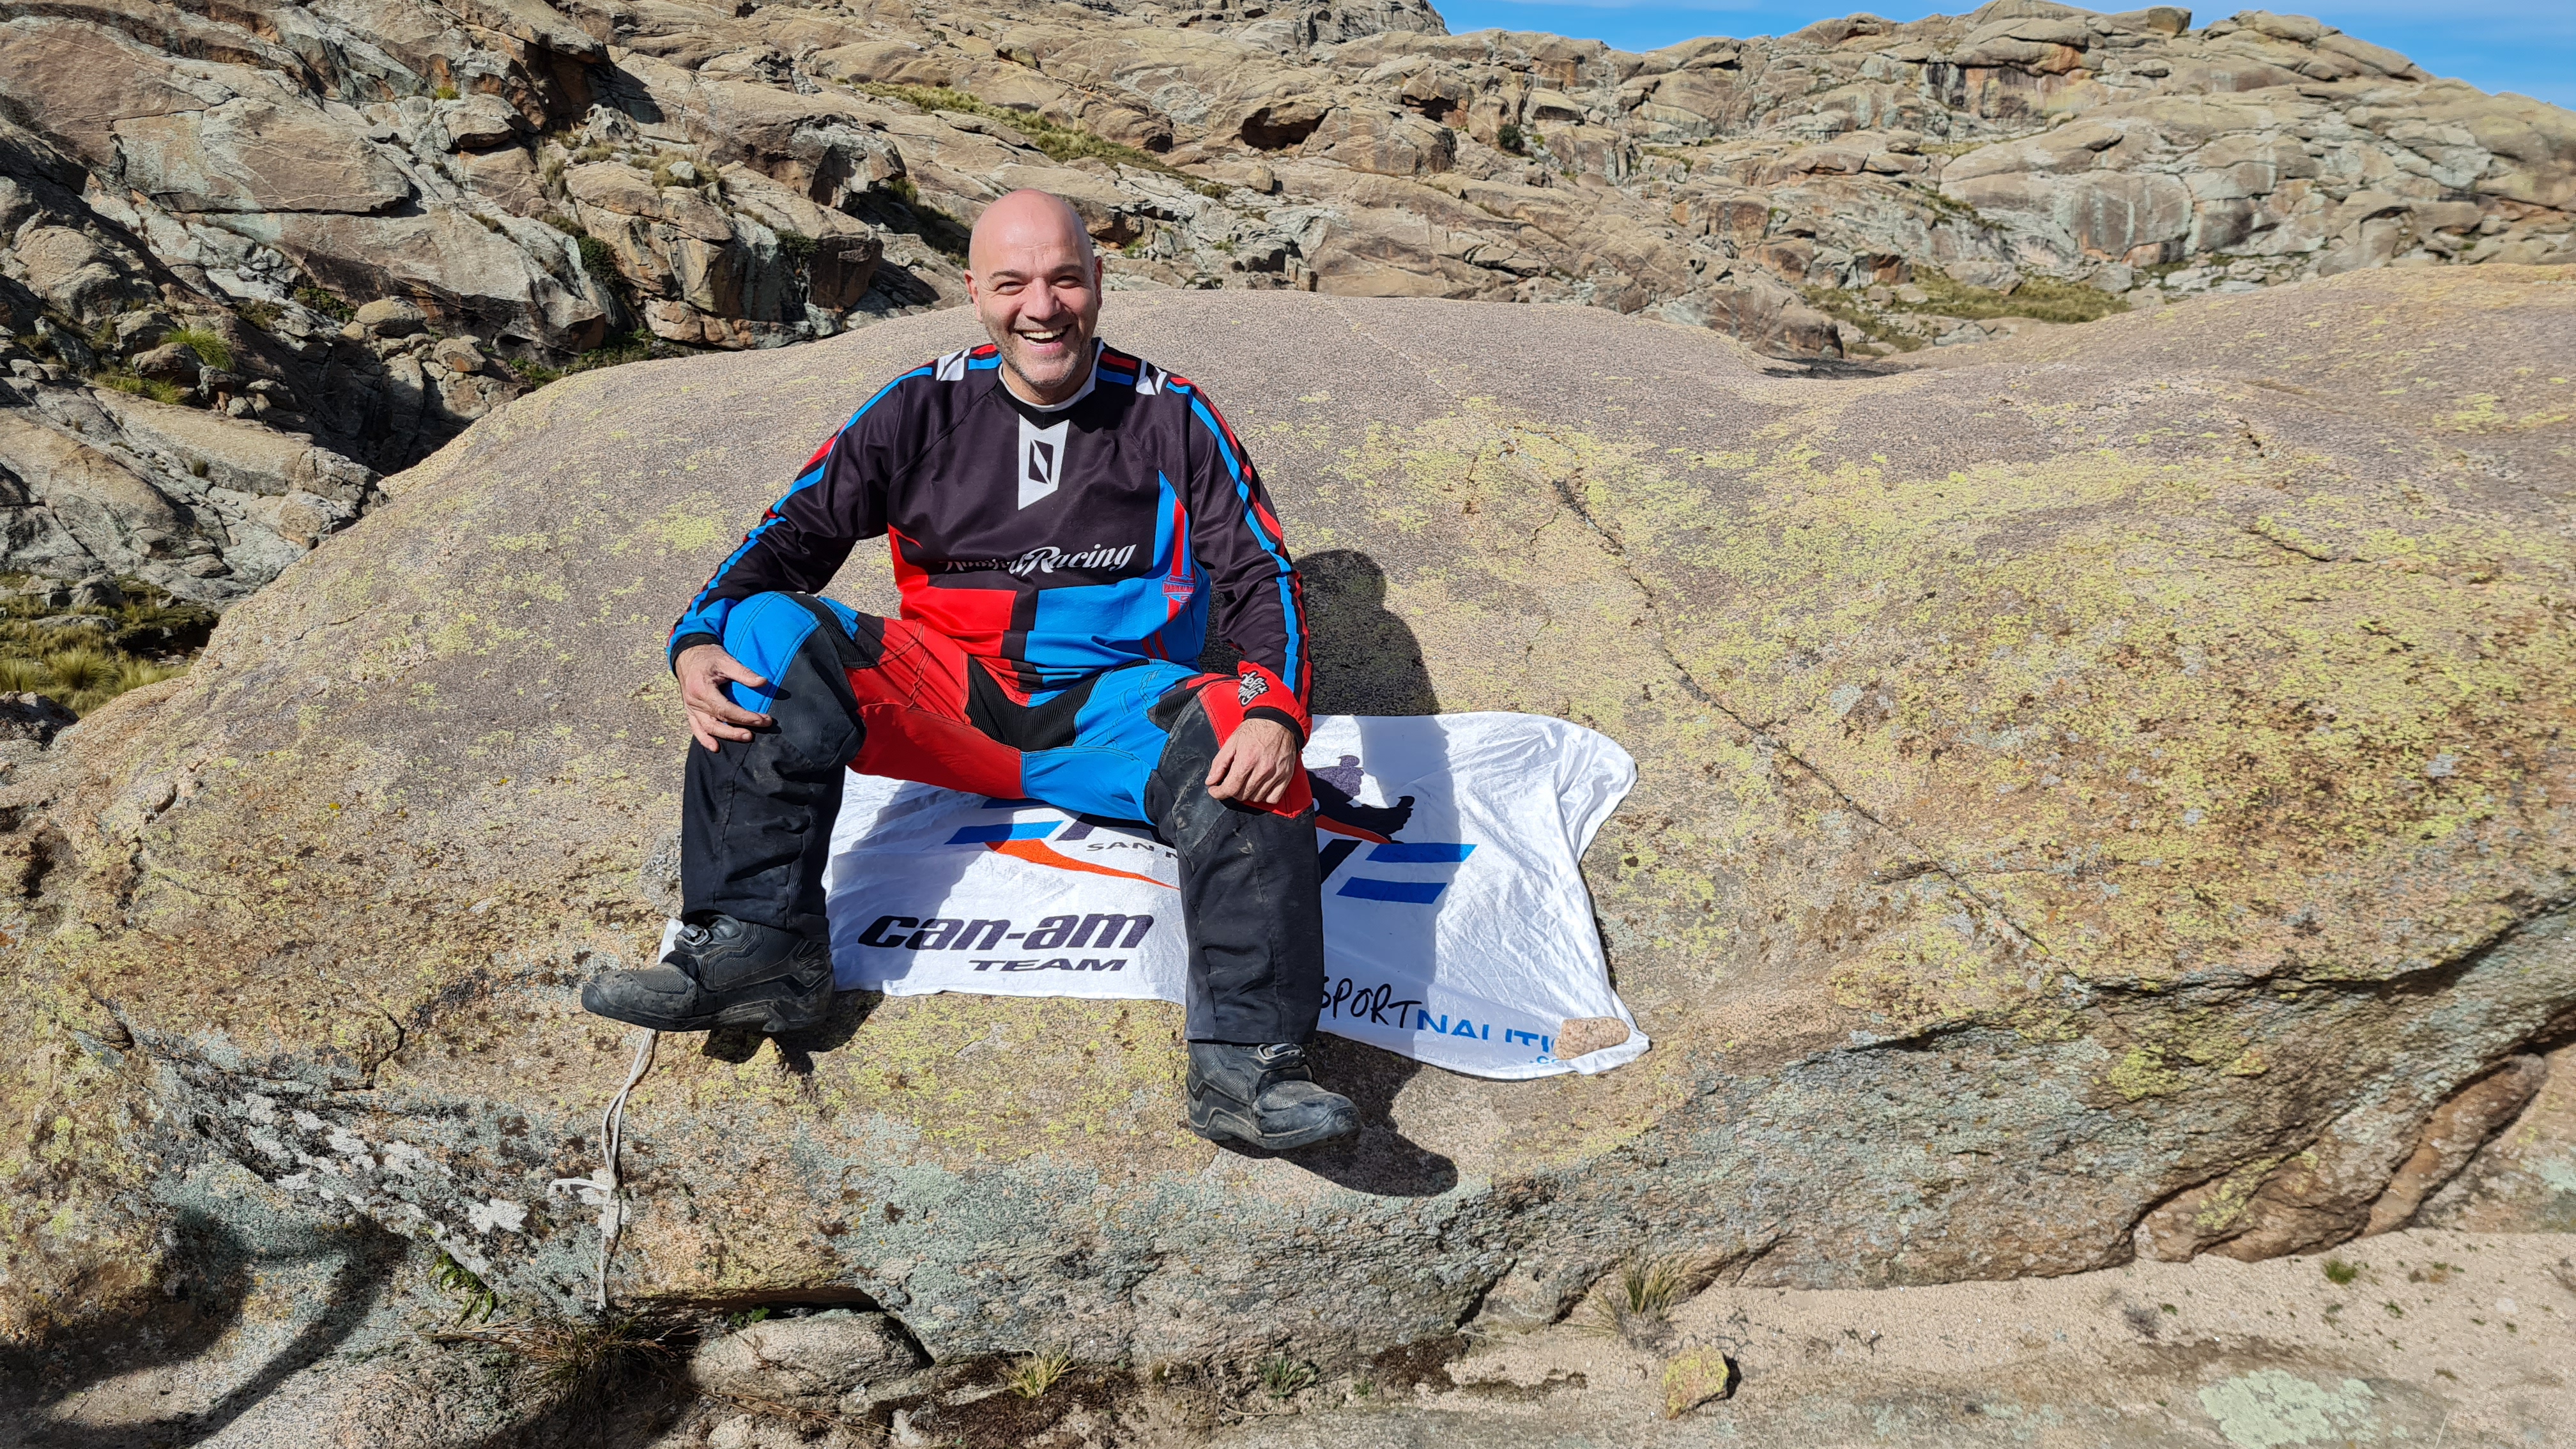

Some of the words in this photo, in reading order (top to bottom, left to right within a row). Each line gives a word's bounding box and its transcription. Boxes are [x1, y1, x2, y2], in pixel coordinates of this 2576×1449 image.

[1022, 544, 1137, 576] Racing
[1087, 841, 1154, 852] SAN
[969, 958, 1128, 972] TEAM
